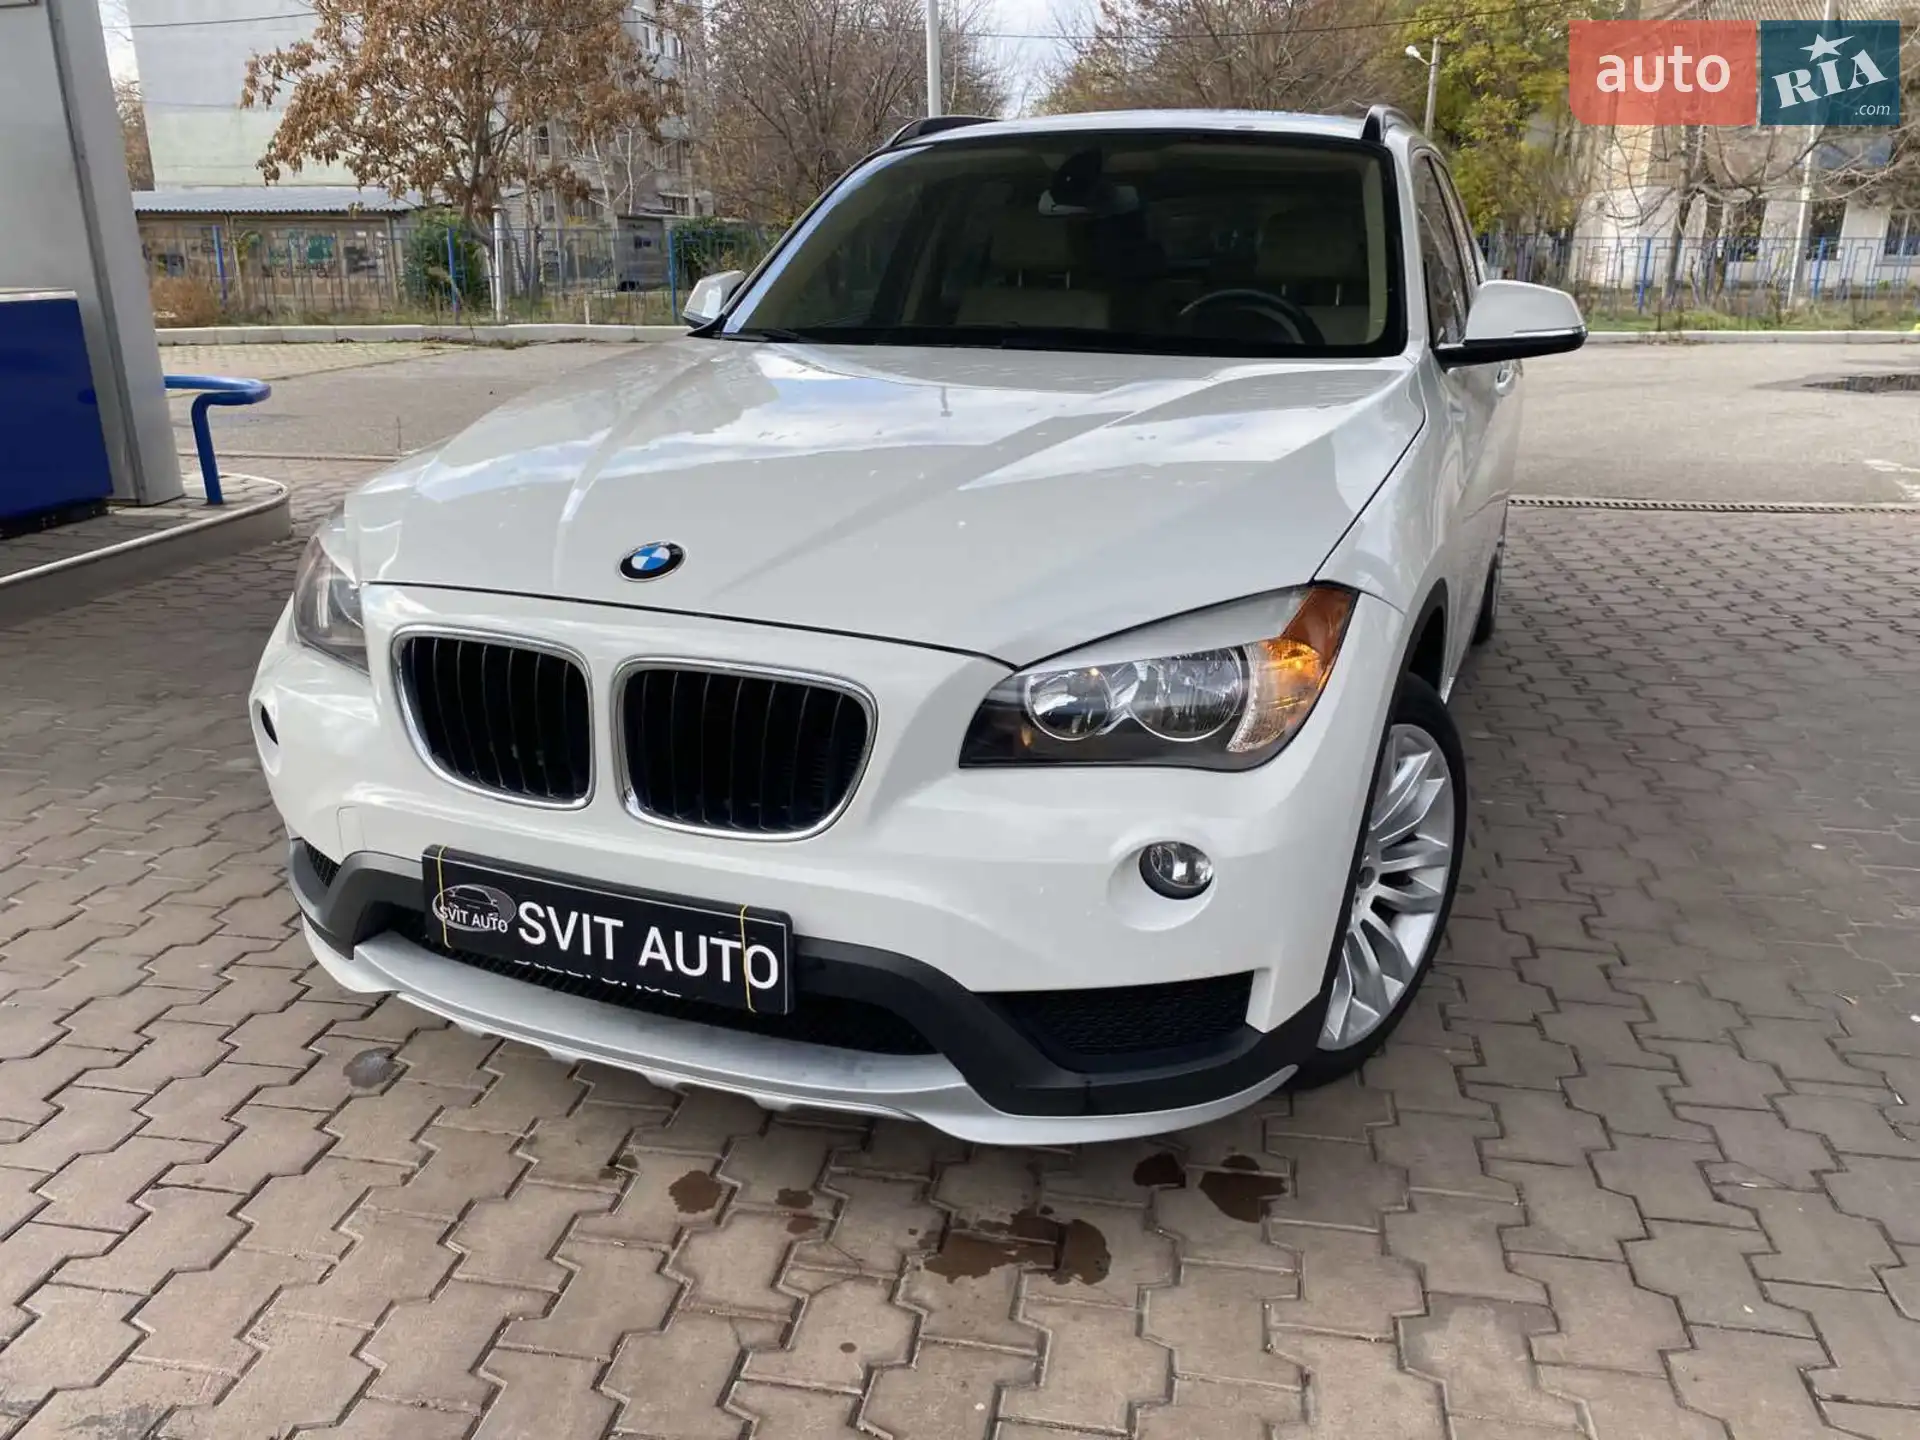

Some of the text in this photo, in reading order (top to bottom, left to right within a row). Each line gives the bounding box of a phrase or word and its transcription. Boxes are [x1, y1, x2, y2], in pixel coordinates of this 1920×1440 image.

[439, 905, 509, 934] SVIT AUTO
[517, 900, 625, 961] SVIT
[638, 925, 780, 990] AUTO
